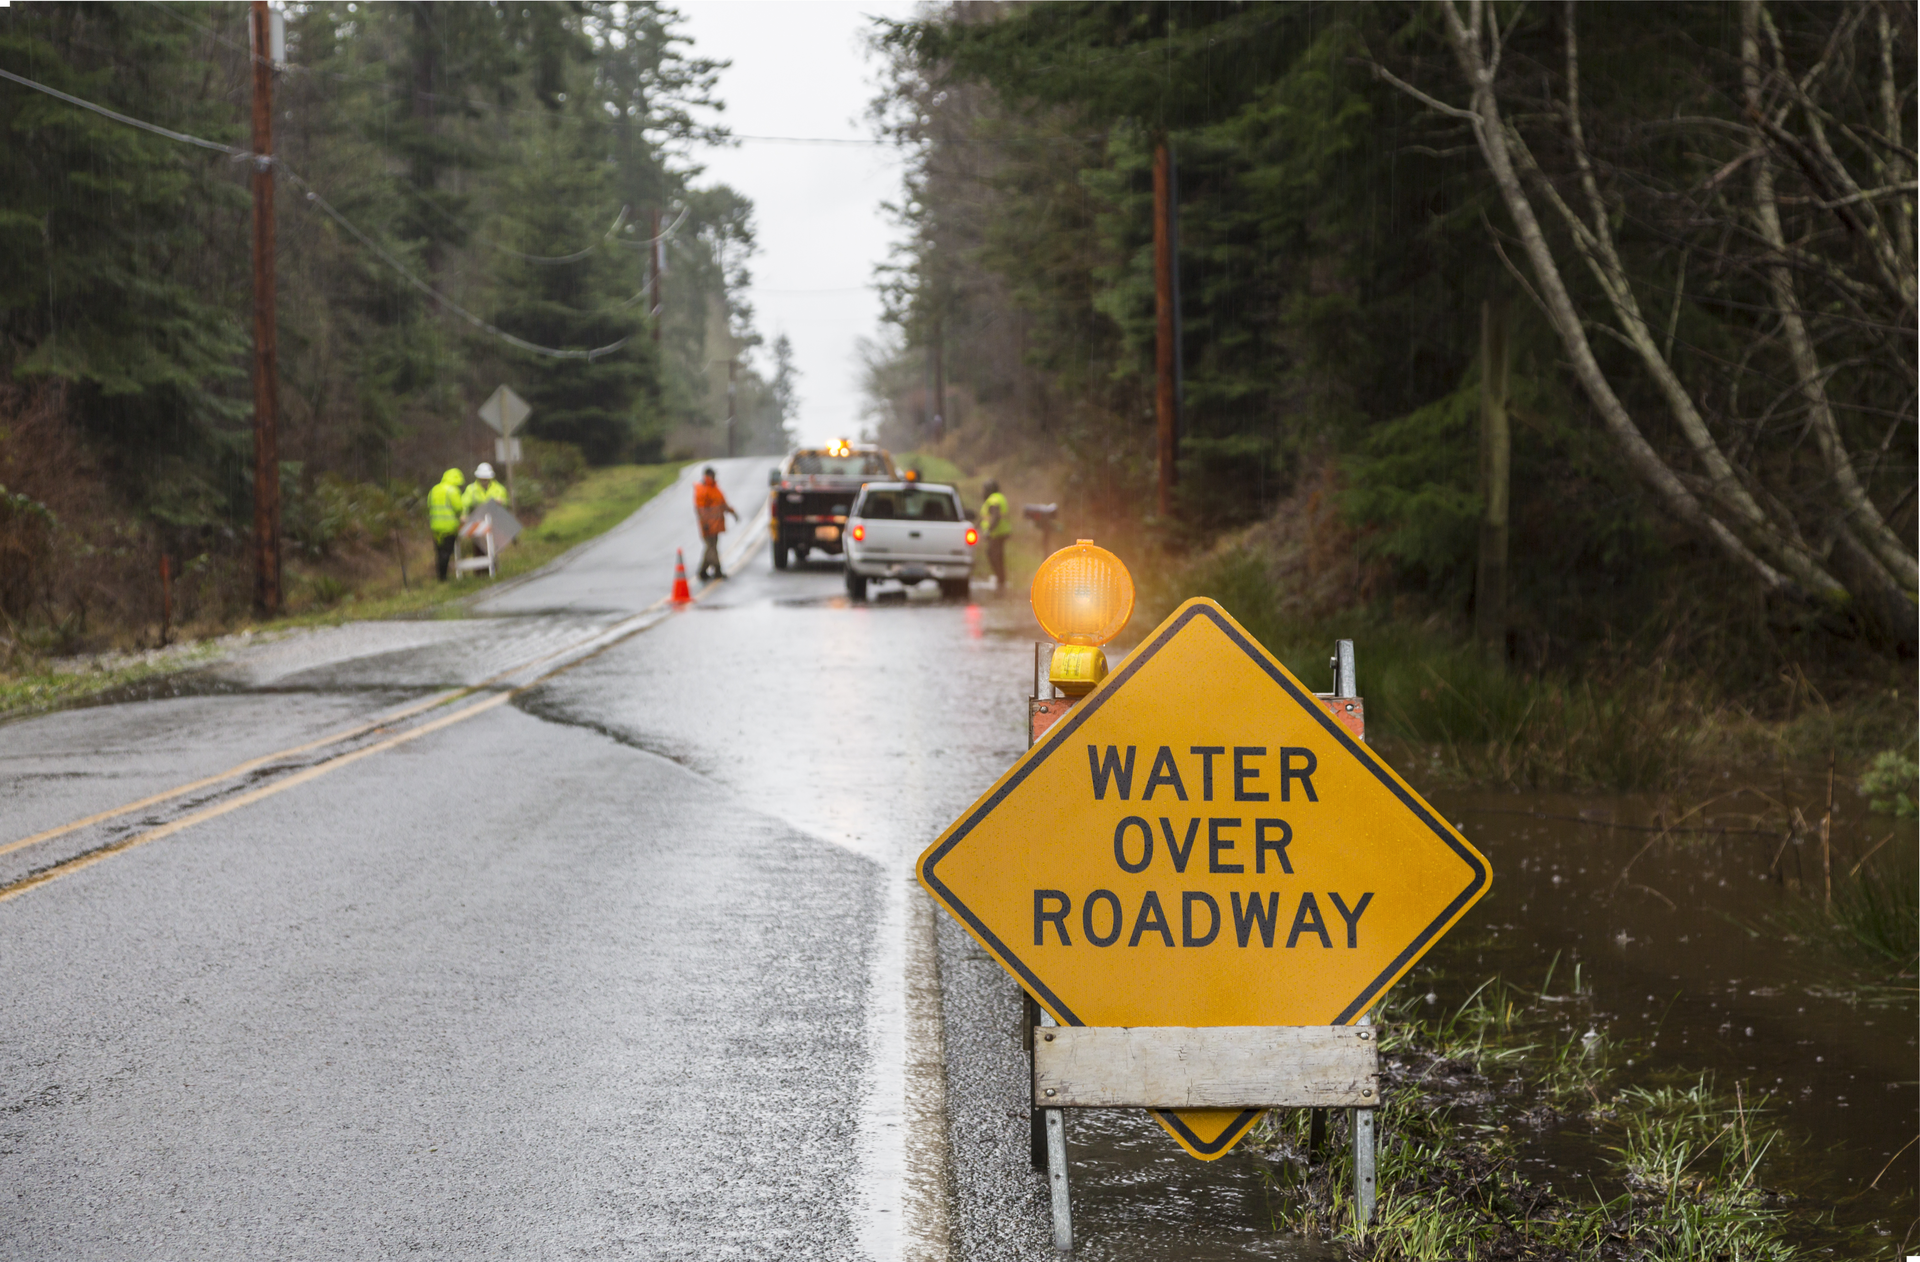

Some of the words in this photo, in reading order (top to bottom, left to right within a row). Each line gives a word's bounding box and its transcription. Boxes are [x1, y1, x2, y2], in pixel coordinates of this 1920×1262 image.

[1087, 744, 1319, 803] WATER
[1113, 815, 1295, 875] OVER
[1033, 888, 1375, 949] ROADWAY
